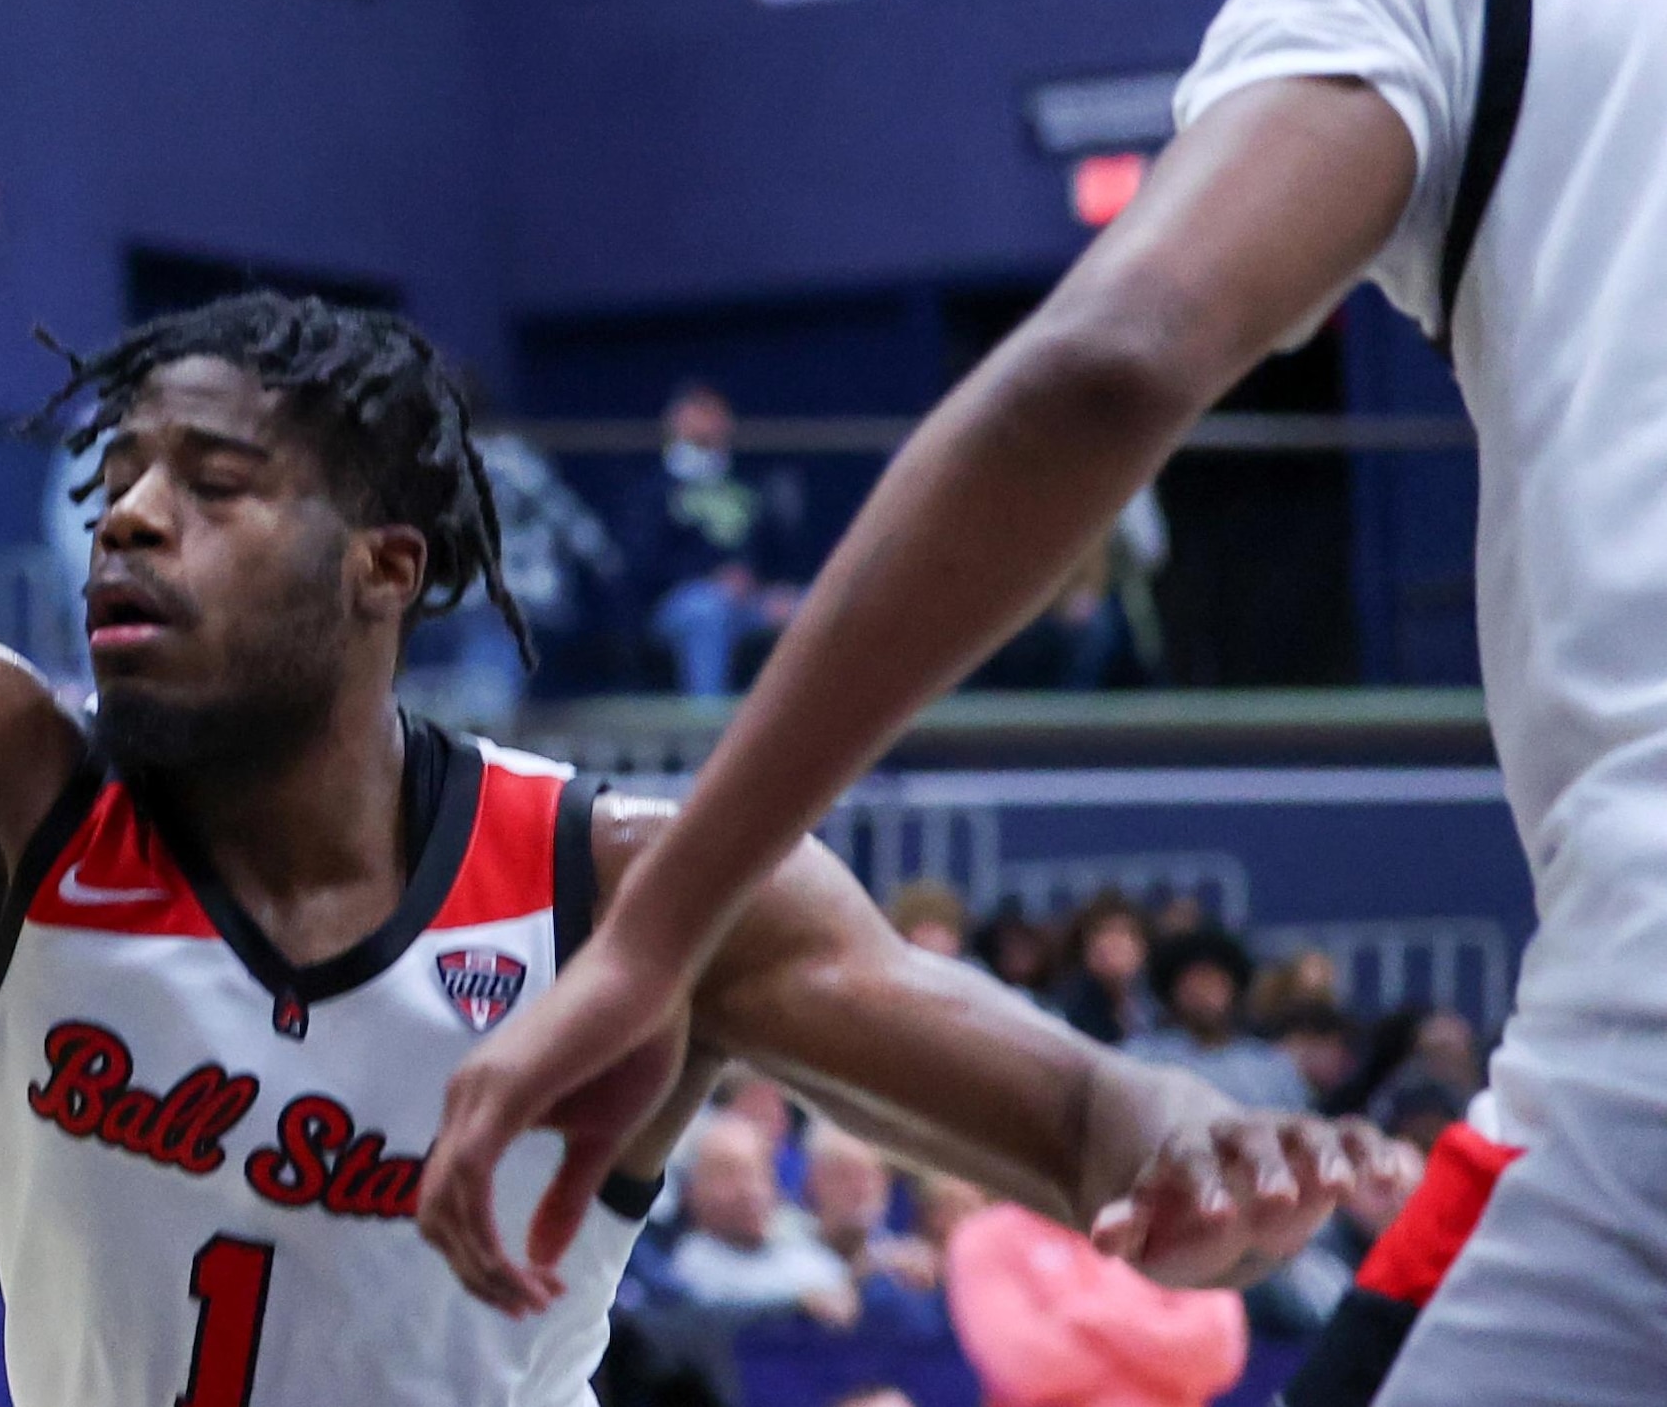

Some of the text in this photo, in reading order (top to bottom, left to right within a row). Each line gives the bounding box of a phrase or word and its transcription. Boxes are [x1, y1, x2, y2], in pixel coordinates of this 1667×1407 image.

[28, 1019, 439, 1219] Ball Sta
[175, 1231, 276, 1407] 1
